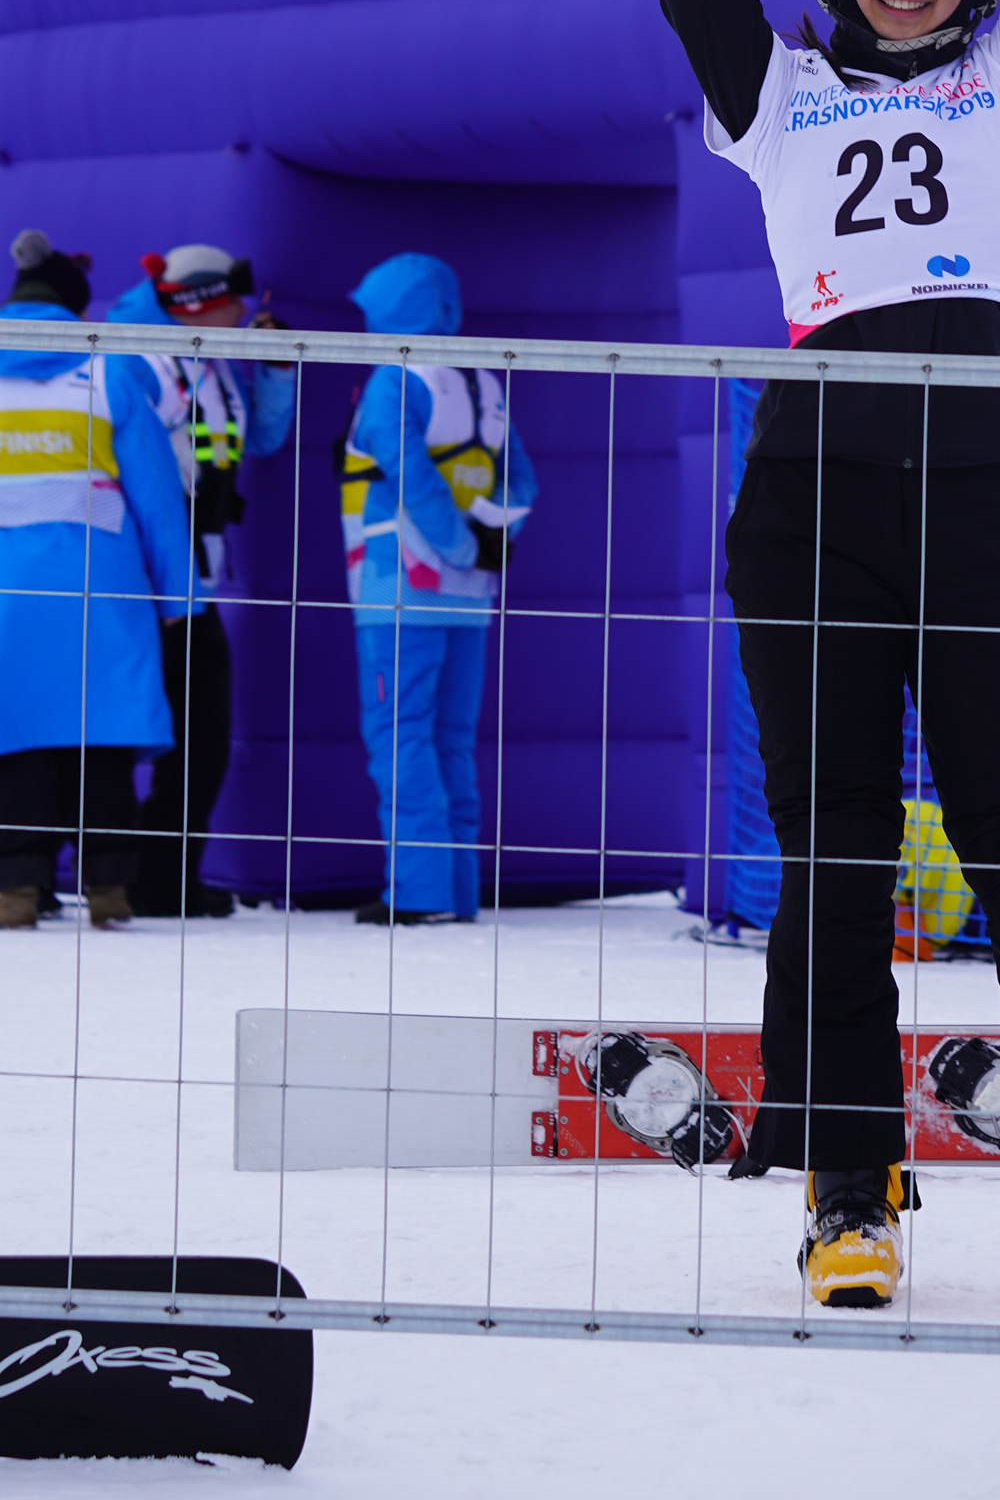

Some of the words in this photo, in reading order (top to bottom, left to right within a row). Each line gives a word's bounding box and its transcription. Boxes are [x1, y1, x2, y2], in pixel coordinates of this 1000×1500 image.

[785, 94, 946, 132] RASNOYARSK
[945, 91, 996, 121] 2019
[835, 131, 949, 238] 23
